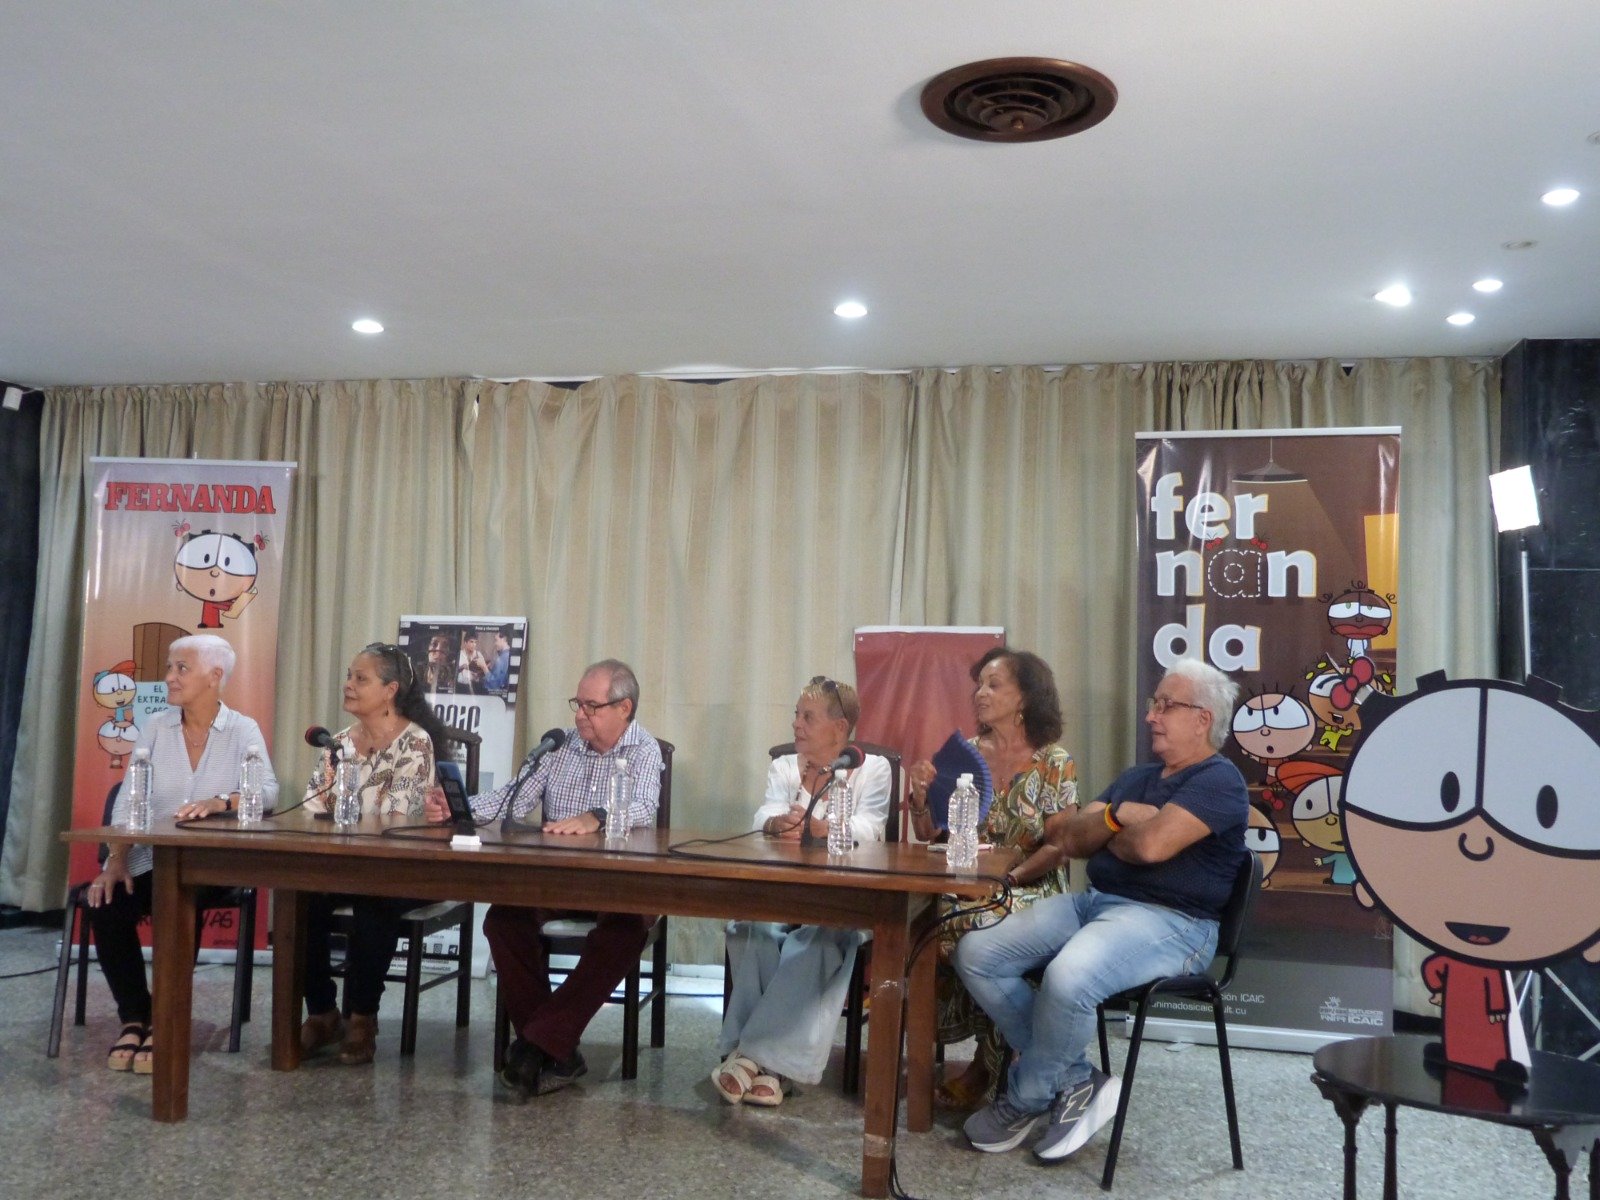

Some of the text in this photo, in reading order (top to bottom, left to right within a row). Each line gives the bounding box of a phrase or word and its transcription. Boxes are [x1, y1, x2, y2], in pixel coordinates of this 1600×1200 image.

[104, 481, 276, 515] FERNANDA
[1151, 471, 1268, 541] fer
[1156, 549, 1317, 598] nan
[1153, 603, 1262, 672] da
[137, 695, 166, 703] EXTRA
[154, 685, 164, 693] EL
[1240, 992, 1265, 1004] ICAIC
